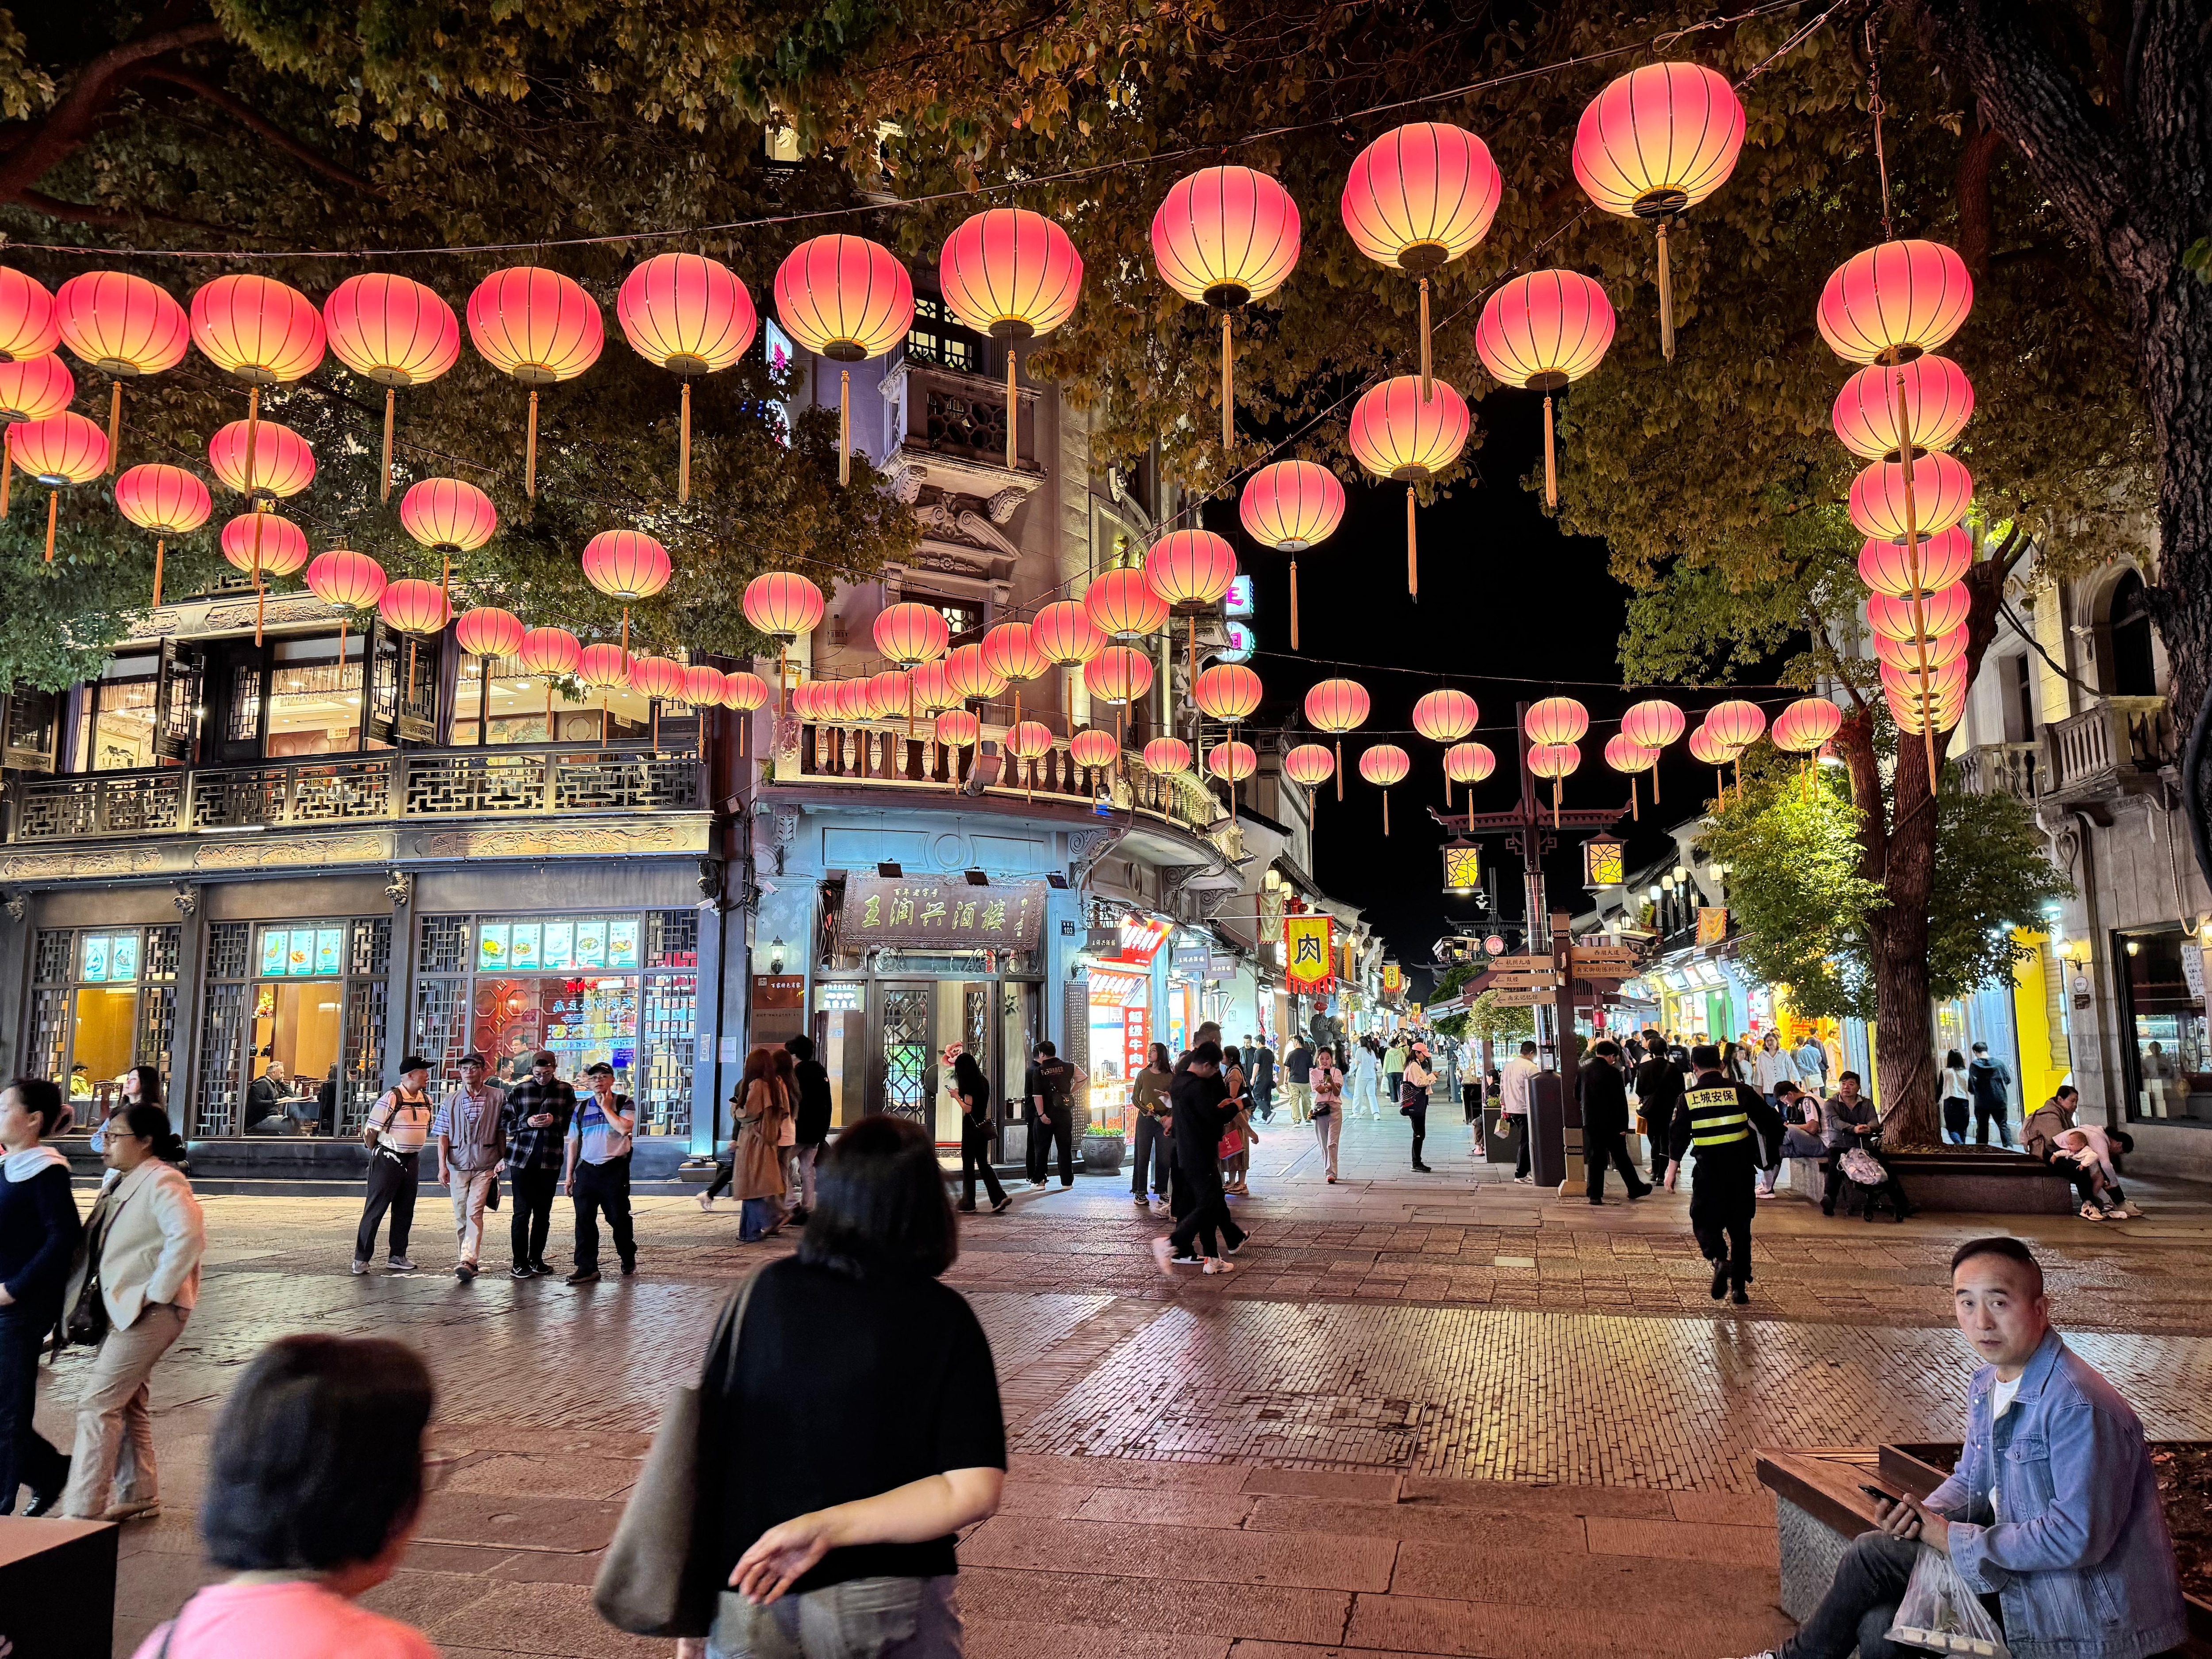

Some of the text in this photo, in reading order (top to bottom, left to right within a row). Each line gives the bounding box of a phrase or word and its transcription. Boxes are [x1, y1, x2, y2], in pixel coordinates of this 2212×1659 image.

[893, 888, 938, 897] 百年老字号
[862, 894, 1006, 931] 王润兴酒楼
[1294, 933, 1321, 965] 肉
[1691, 1090, 1734, 1105] 上城安保
